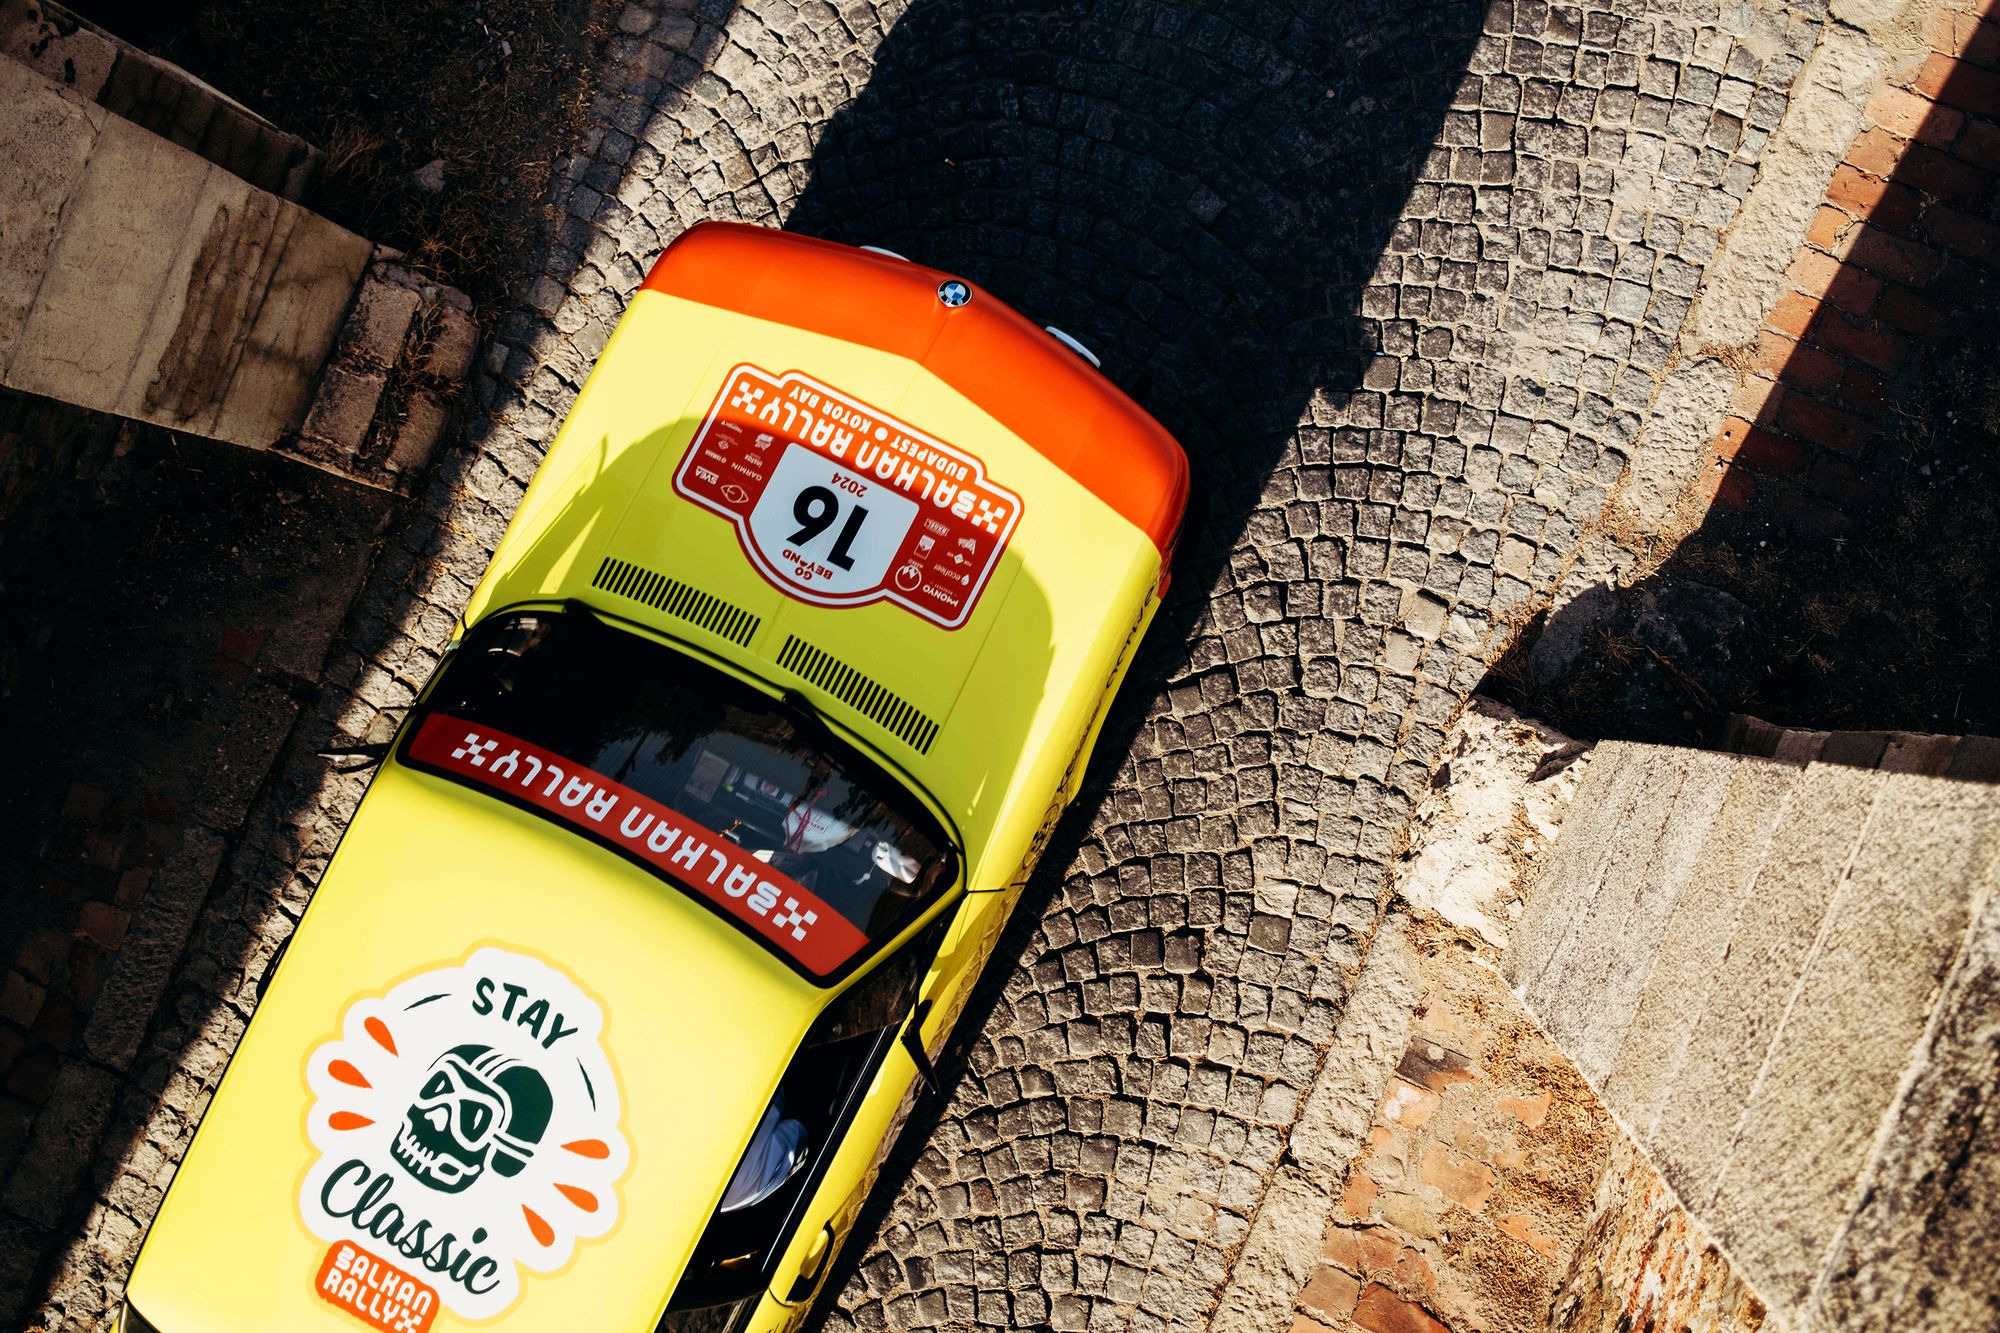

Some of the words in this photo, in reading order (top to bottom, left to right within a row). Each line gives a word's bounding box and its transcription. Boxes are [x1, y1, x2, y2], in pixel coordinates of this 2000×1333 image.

[788, 386, 820, 409] BAY
[821, 400, 872, 434] KOTOR
[758, 396, 854, 458] RALLY
[695, 466, 719, 485] SVEA
[731, 462, 763, 482] GARMIN
[831, 473, 868, 498] 2024
[855, 440, 977, 519] BALKAN
[890, 436, 969, 482] BUDAPEST
[785, 486, 869, 572] 16
[795, 567, 812, 580] GO
[922, 584, 959, 607] MONYO
[489, 749, 619, 822] RALLY
[620, 806, 782, 916] BALKAN
[472, 977, 579, 1050] STAY
[320, 1159, 501, 1295] Classic
[335, 1245, 432, 1316] BALKAN
